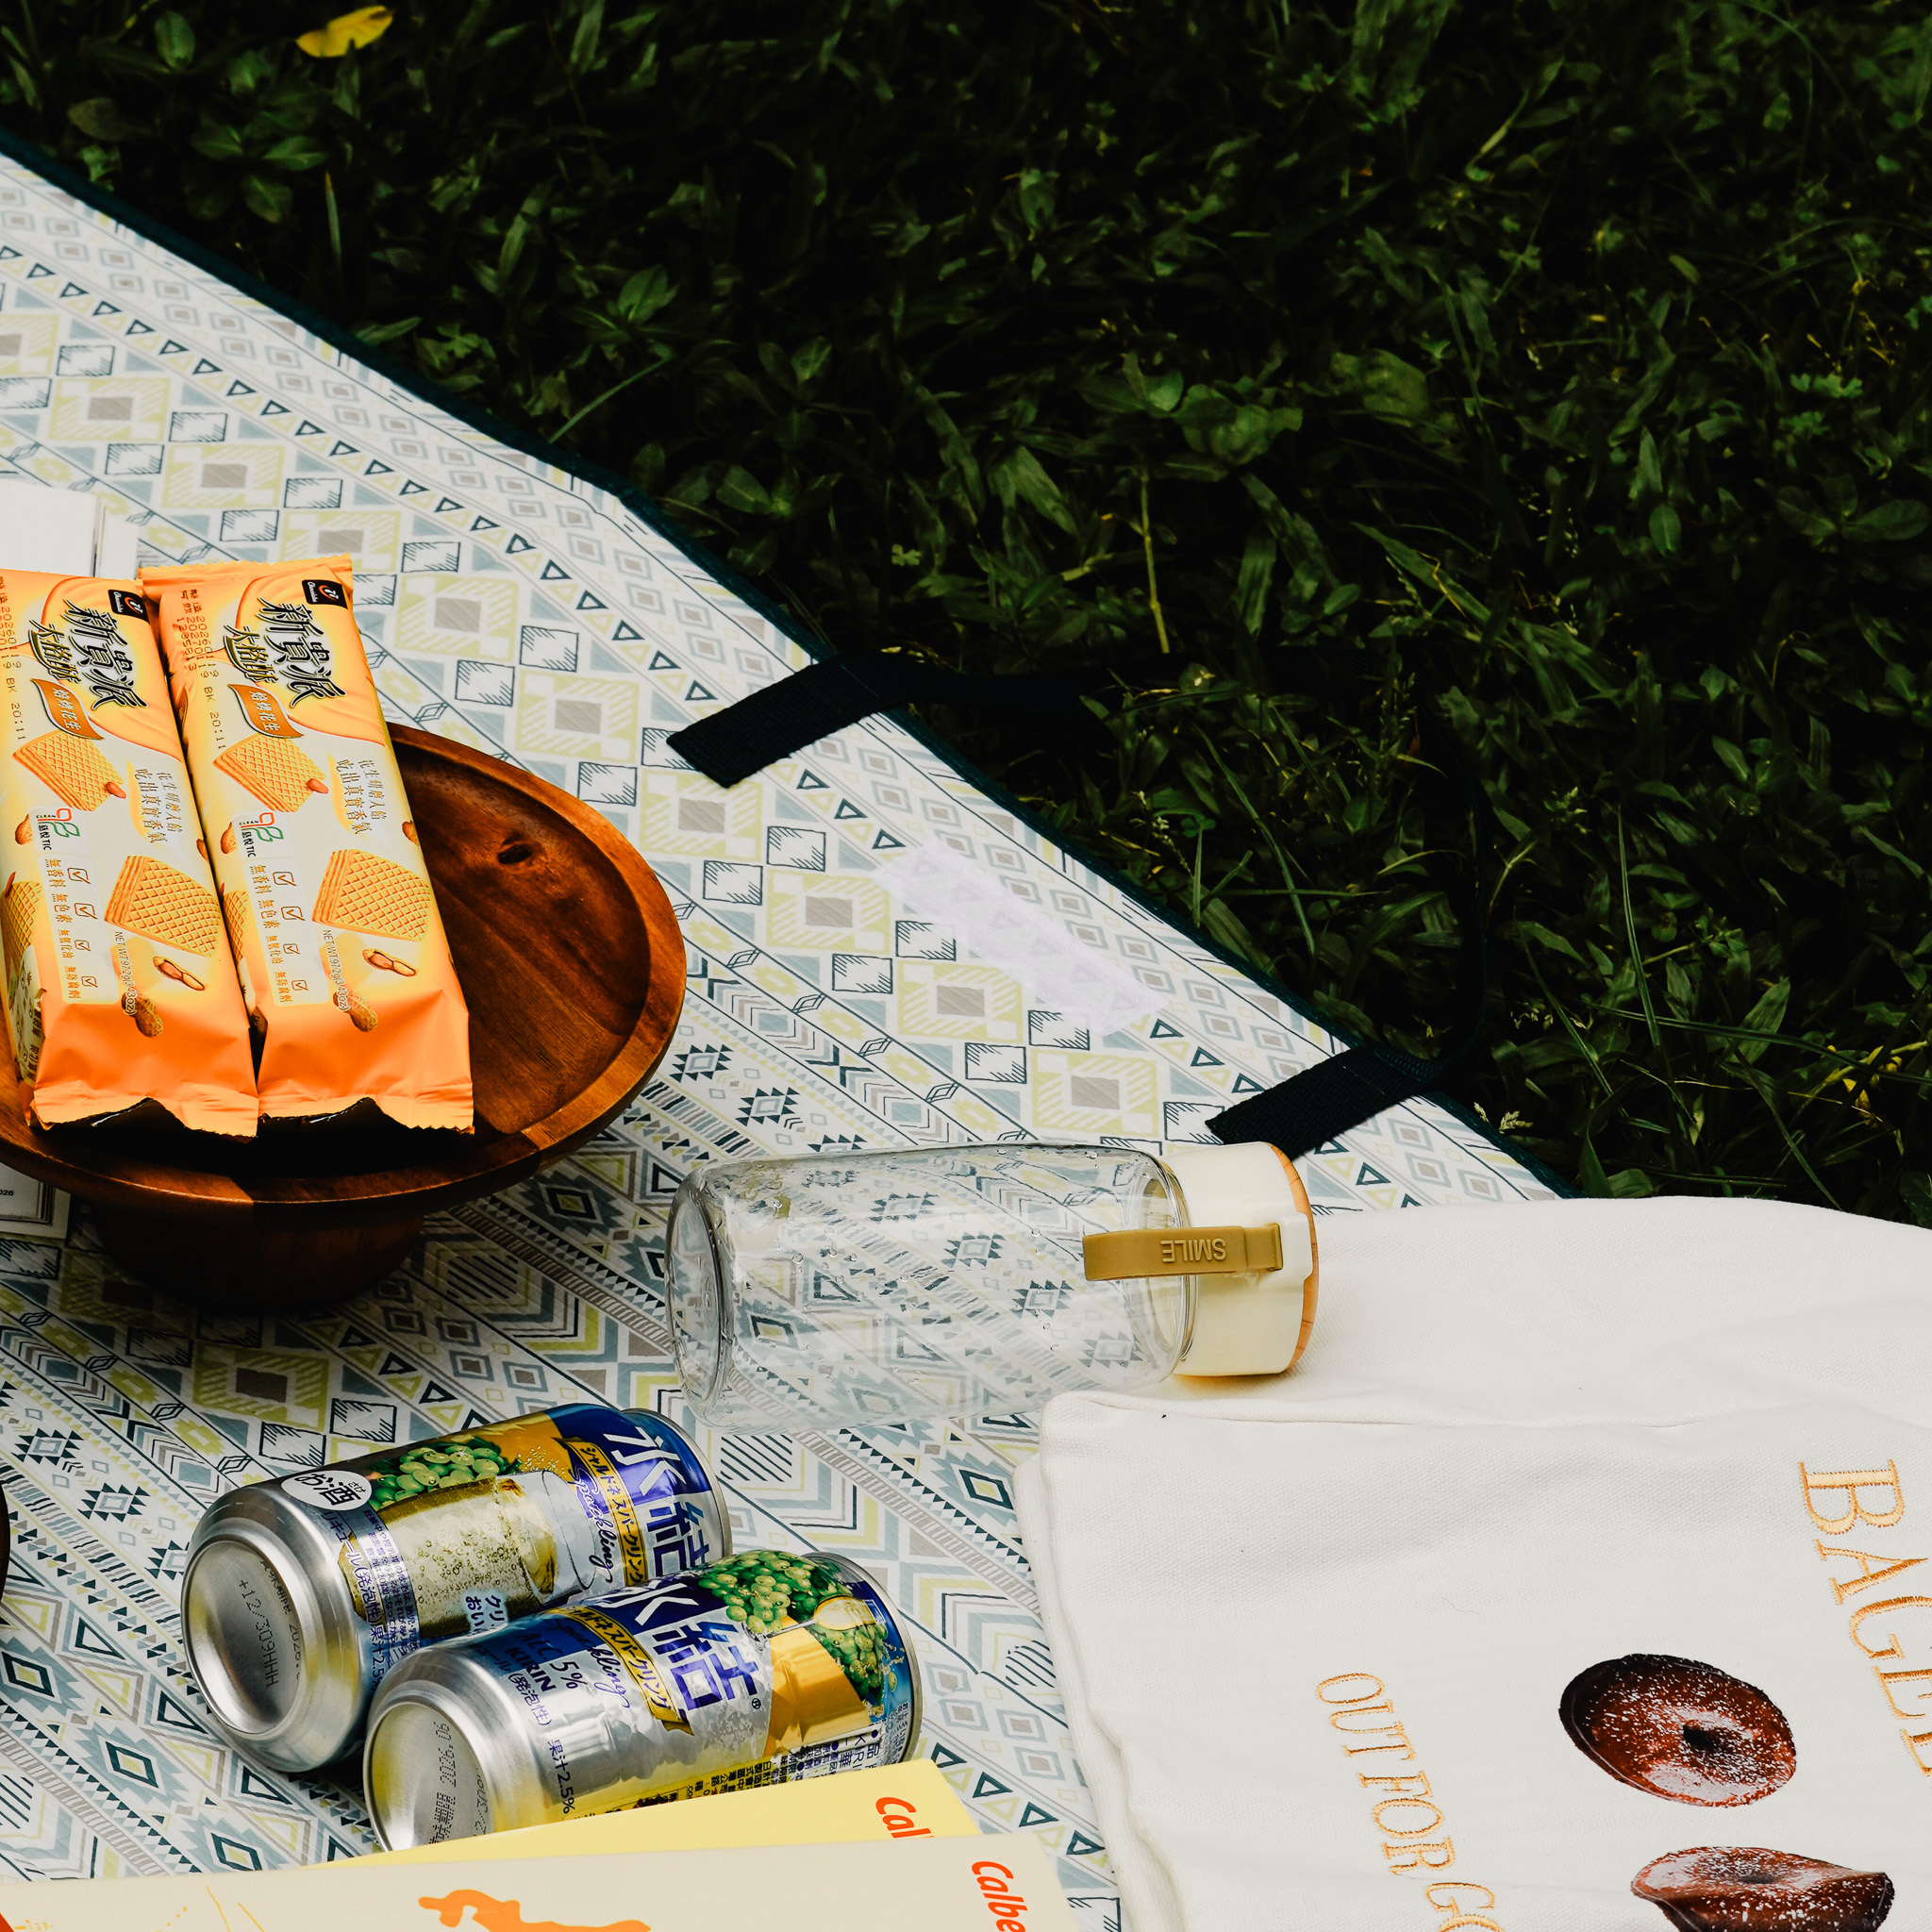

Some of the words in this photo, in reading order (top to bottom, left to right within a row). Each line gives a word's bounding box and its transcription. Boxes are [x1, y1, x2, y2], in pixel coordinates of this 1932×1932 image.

[60, 598, 148, 710] 新貴派
[255, 596, 347, 708] 新貴派
[10, 703, 25, 740] 20:11
[209, 711, 226, 750] 20:11
[134, 769, 167, 843] 吃出真實香氣
[336, 758, 373, 835] 吃出真實香氣
[44, 858, 66, 888] 無香料
[249, 865, 272, 893] 無香料
[51, 893, 73, 924] 無色素
[258, 899, 280, 929] 無色素
[1160, 1238, 1226, 1263] SMILE
[293, 1474, 362, 1507] お酒
[570, 1464, 616, 1583] Sparkling
[466, 1595, 482, 1635] おい
[485, 1594, 505, 1625] クリ
[506, 1647, 557, 1692] KIRIN
[549, 1662, 589, 1690] 5%
[1315, 1673, 1415, 1760] OUT
[548, 1740, 575, 1812] 果汁2.5%
[875, 1796, 934, 1839] Cal
[1357, 1770, 1456, 1875] FOR
[1424, 1882, 1505, 1932] G
